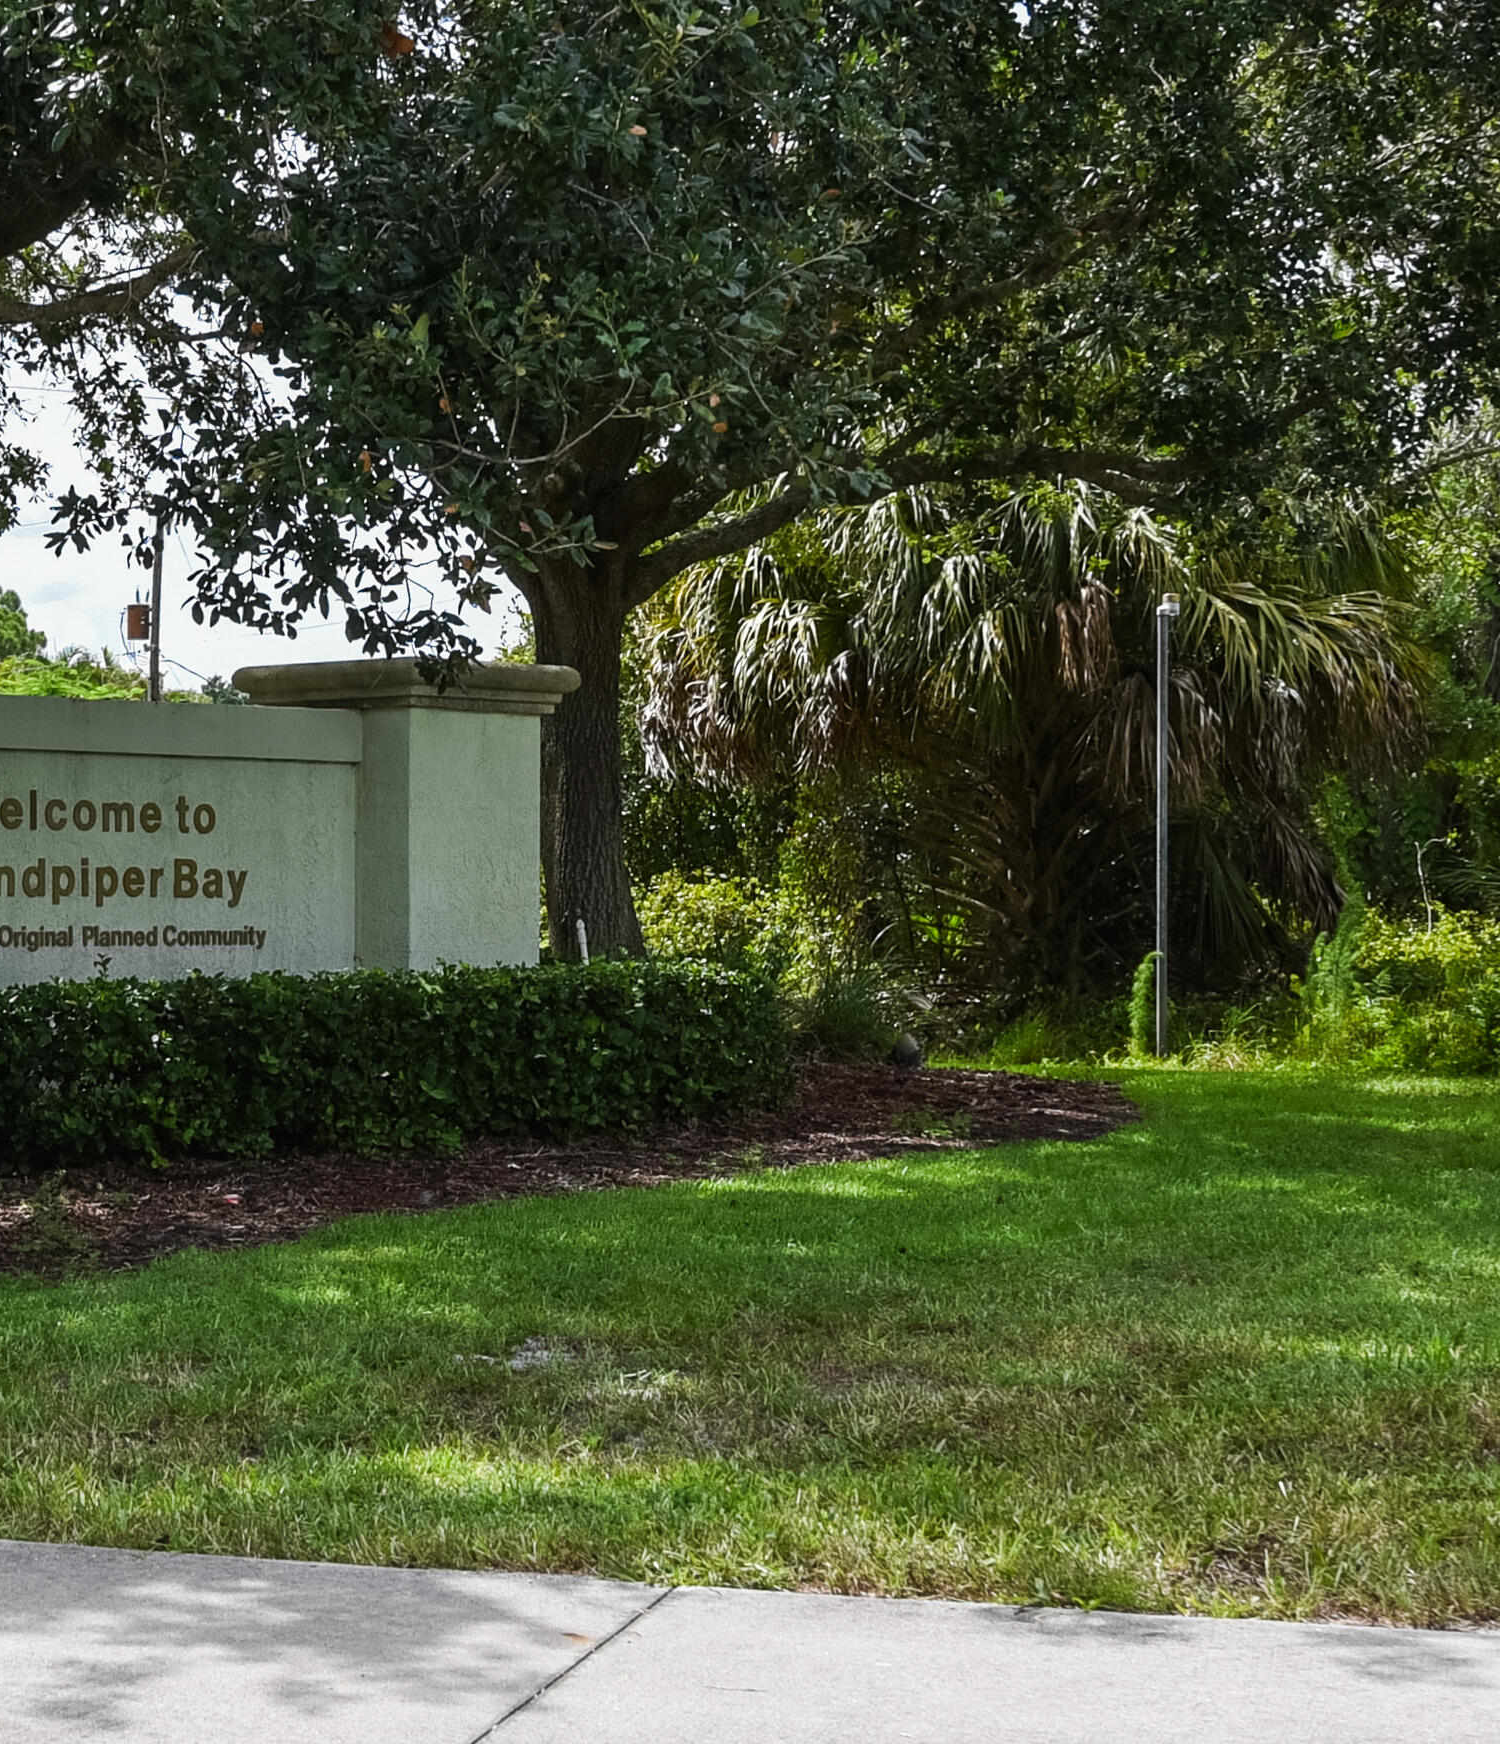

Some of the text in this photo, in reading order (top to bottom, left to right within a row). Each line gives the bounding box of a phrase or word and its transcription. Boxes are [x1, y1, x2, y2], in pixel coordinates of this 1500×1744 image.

[175, 795, 217, 835] to
[173, 858, 249, 908] Bay
[82, 925, 158, 948] Planned
[162, 925, 267, 950] Community
